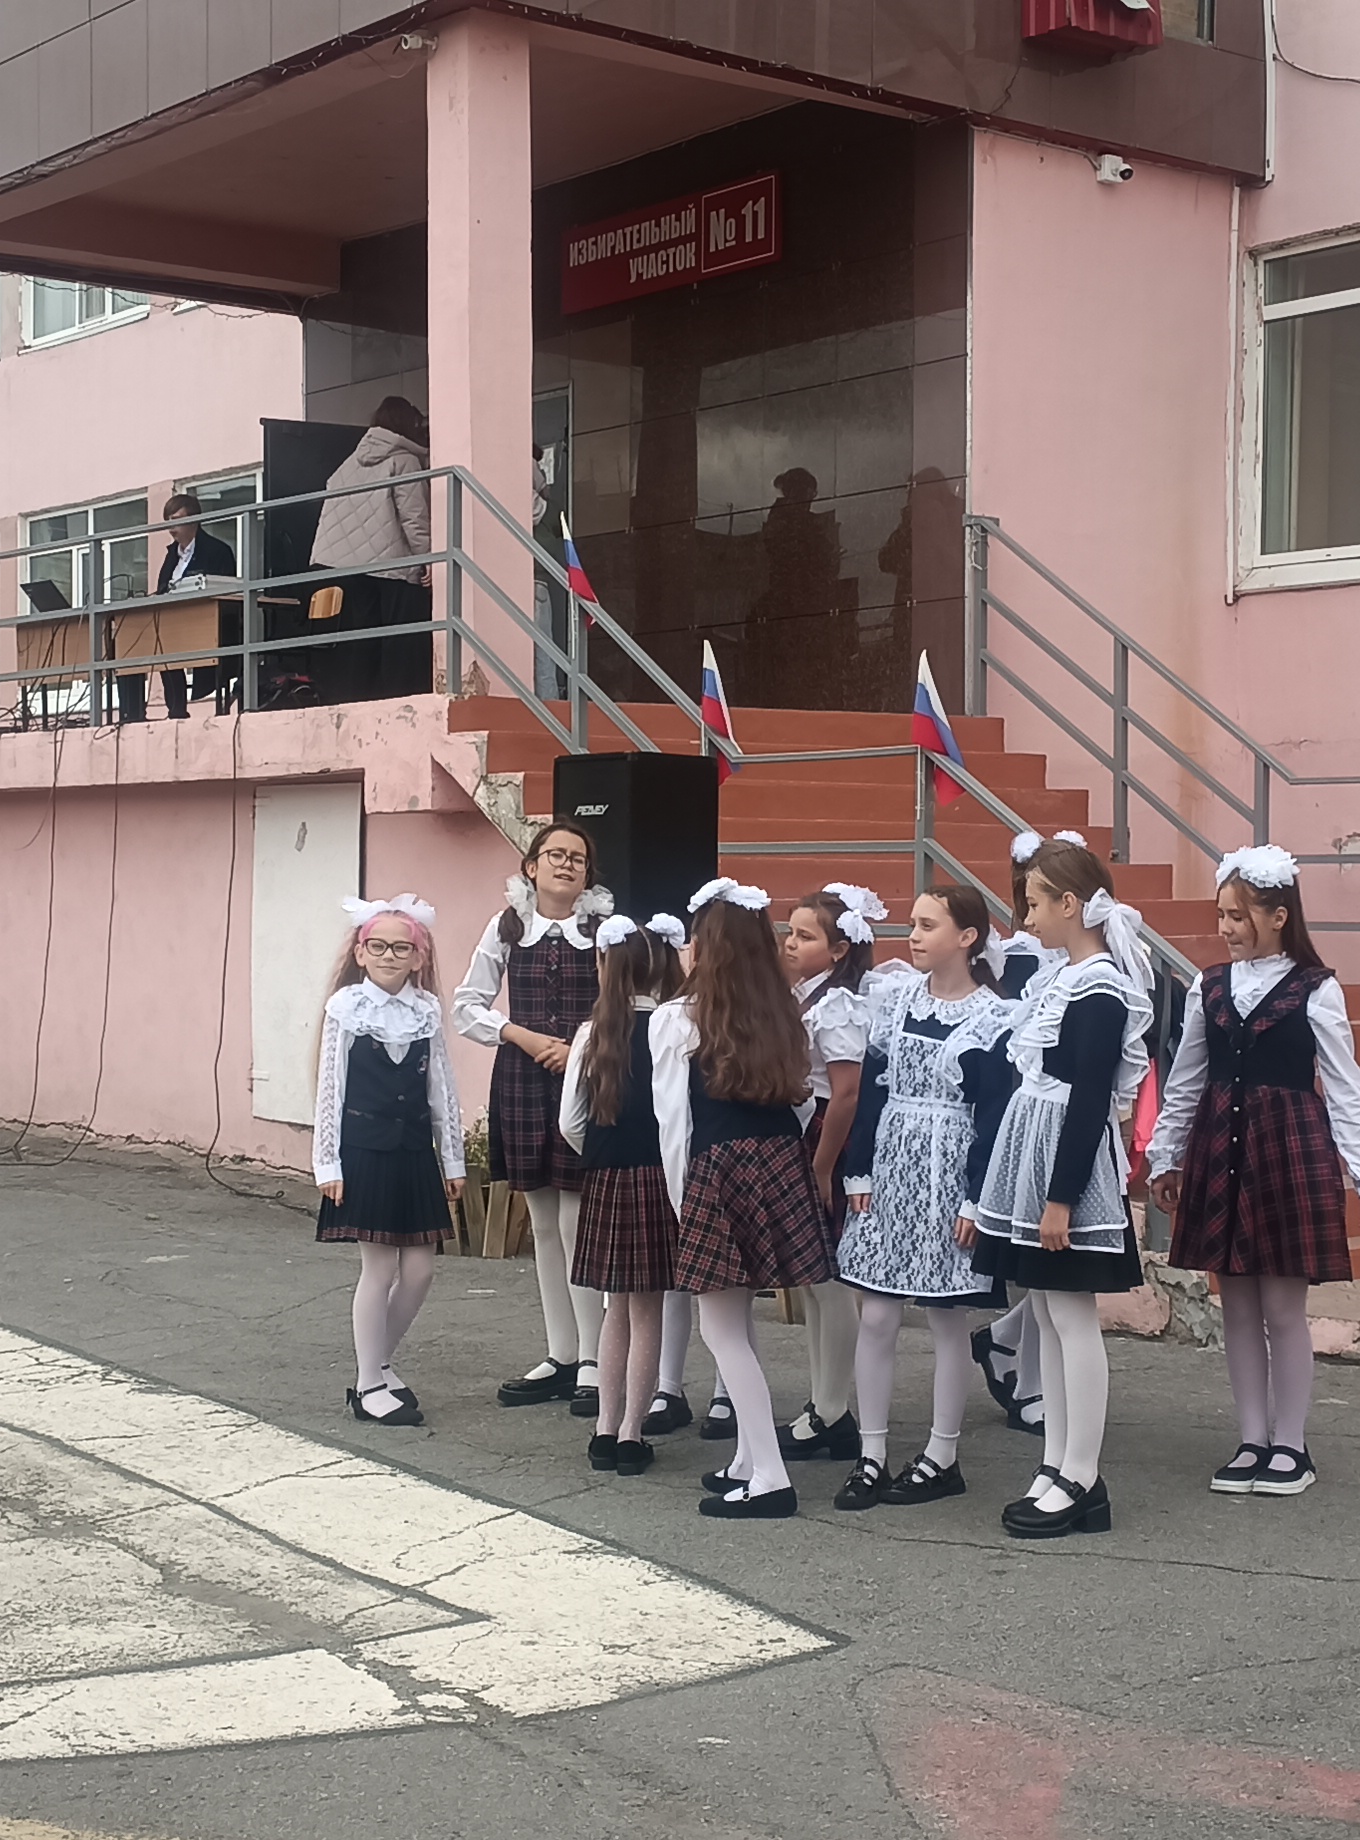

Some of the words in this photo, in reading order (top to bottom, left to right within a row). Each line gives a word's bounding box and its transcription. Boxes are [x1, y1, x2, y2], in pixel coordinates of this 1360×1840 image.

[569, 203, 696, 267] ИЗБИРАТЕЛЬНЫЙ
[709, 208, 737, 252] №
[741, 196, 766, 242] 11
[629, 241, 696, 283] УЧАСТОК
